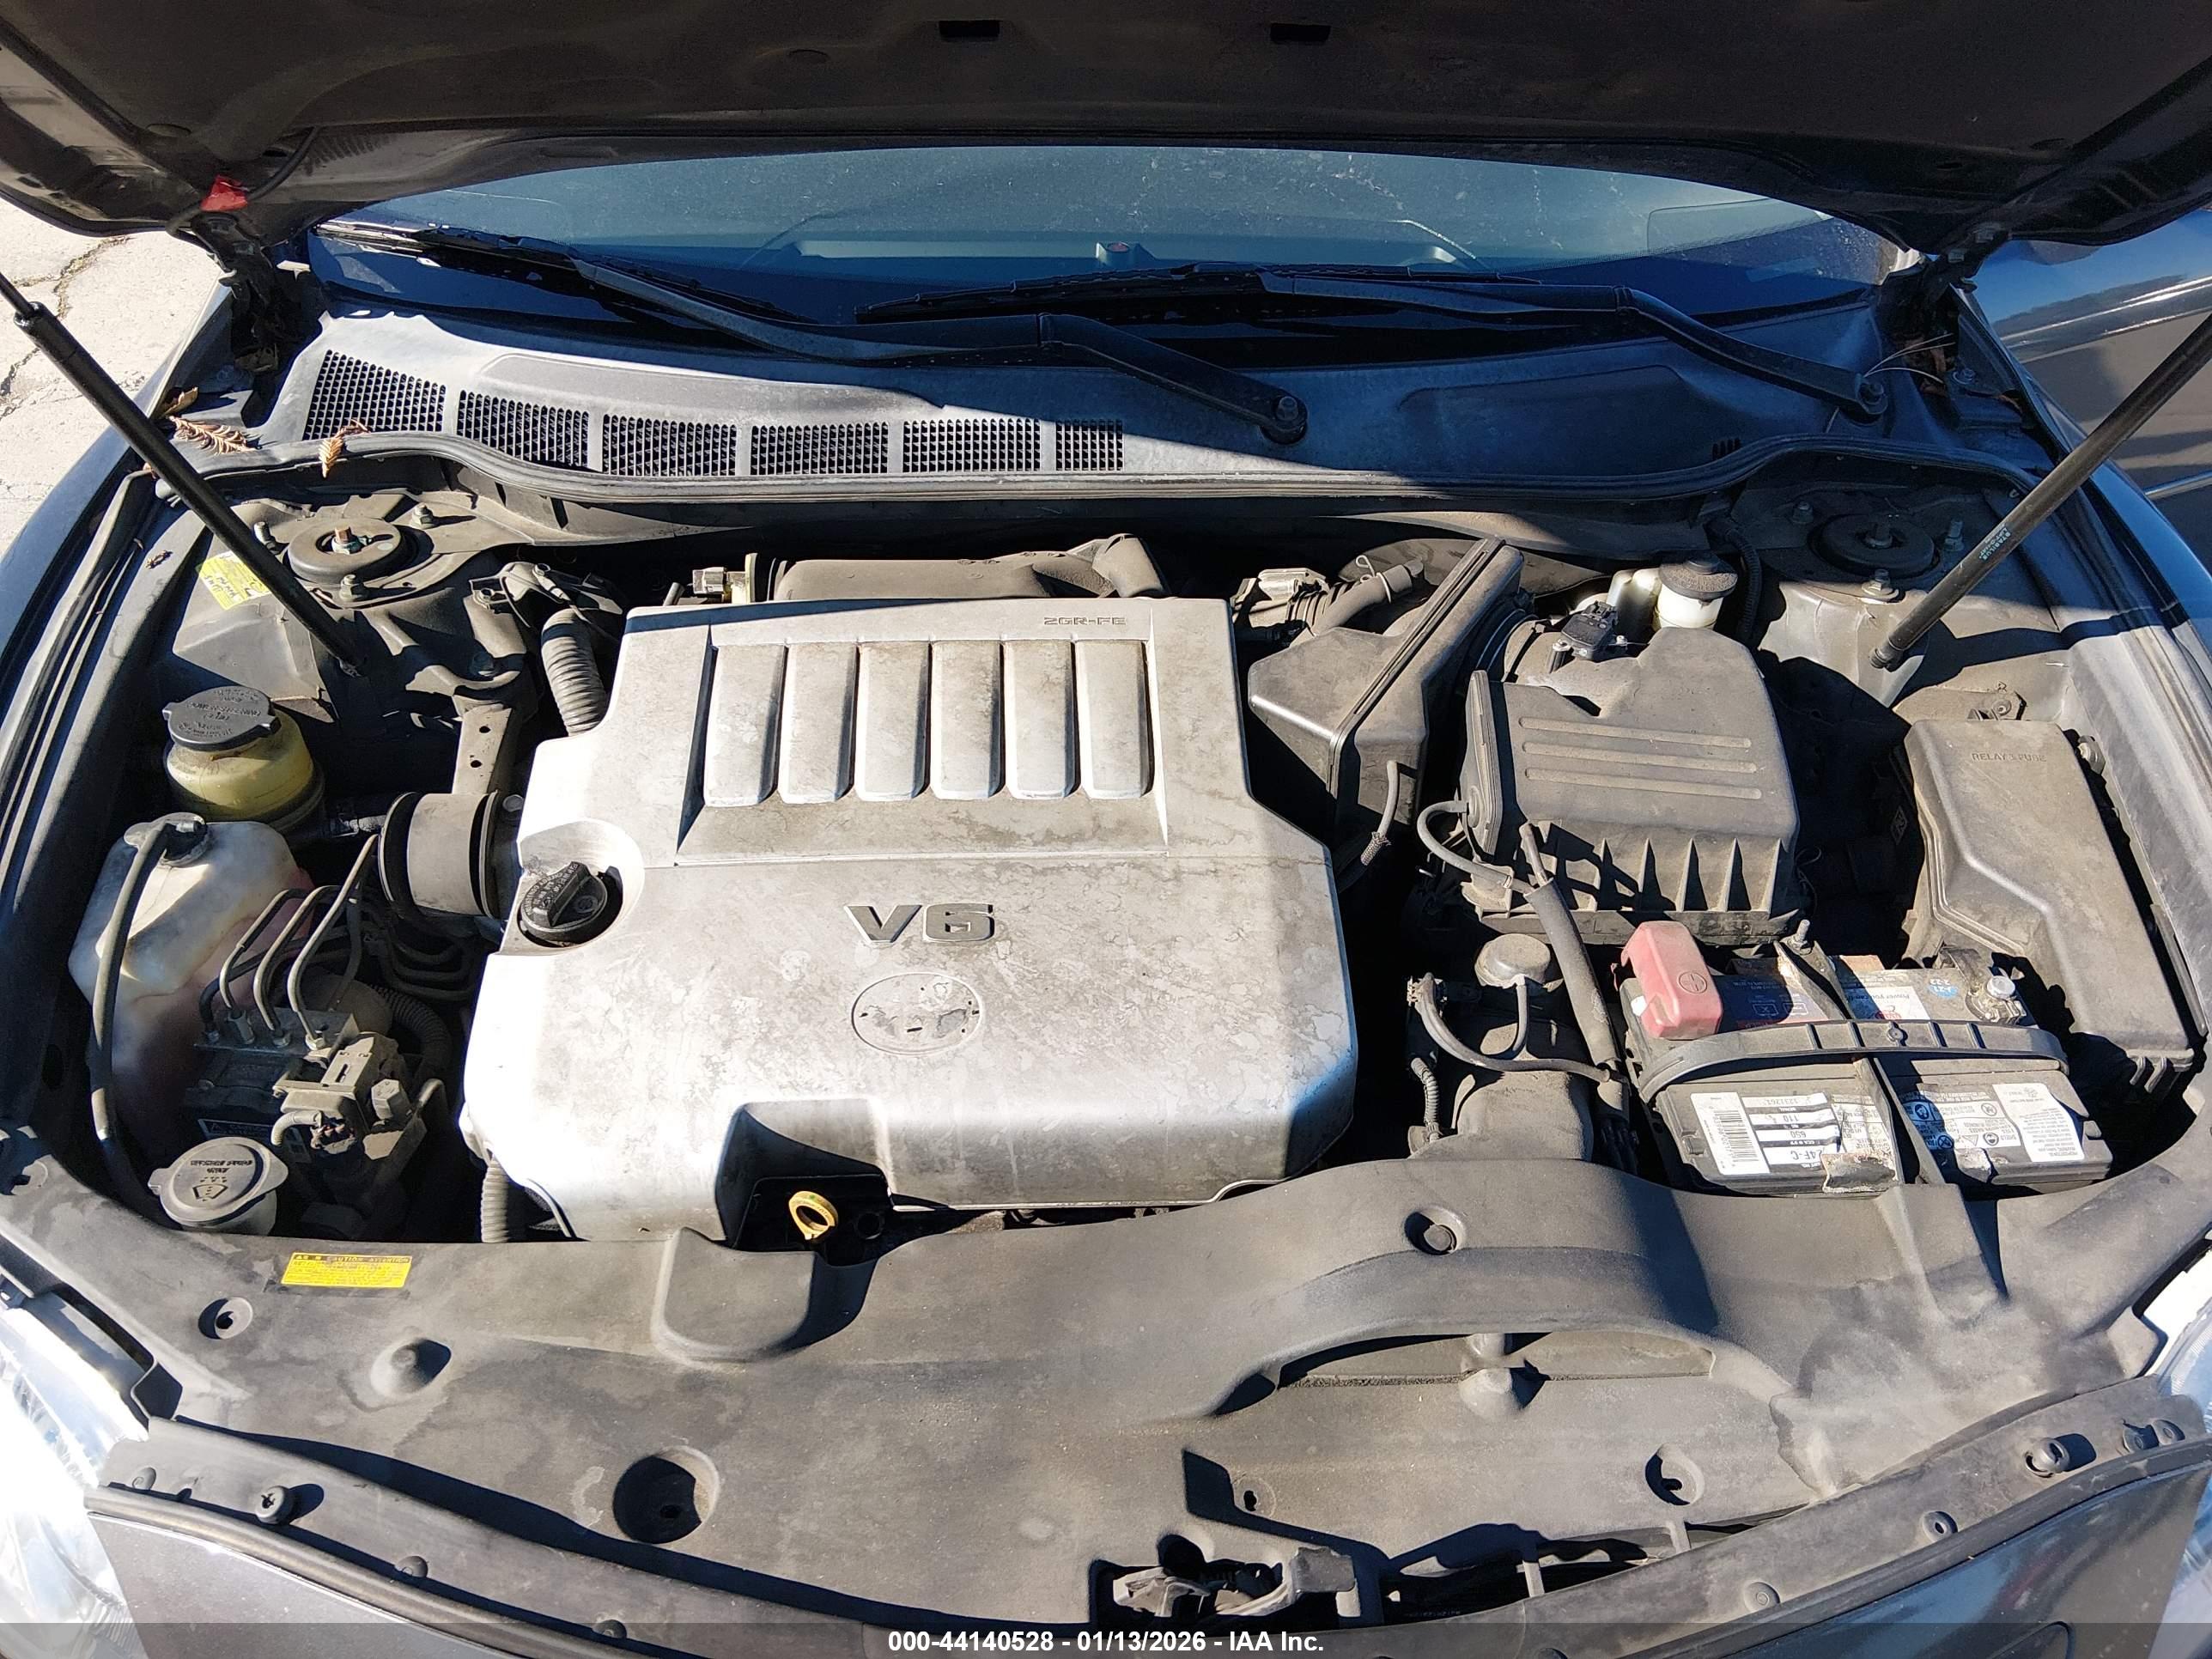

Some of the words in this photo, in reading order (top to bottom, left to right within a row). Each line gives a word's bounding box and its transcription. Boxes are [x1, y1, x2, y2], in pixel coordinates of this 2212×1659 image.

[1043, 617, 1127, 626] 2GR-FE
[843, 903, 995, 944] V6
[1790, 1130, 1807, 1139] 650
